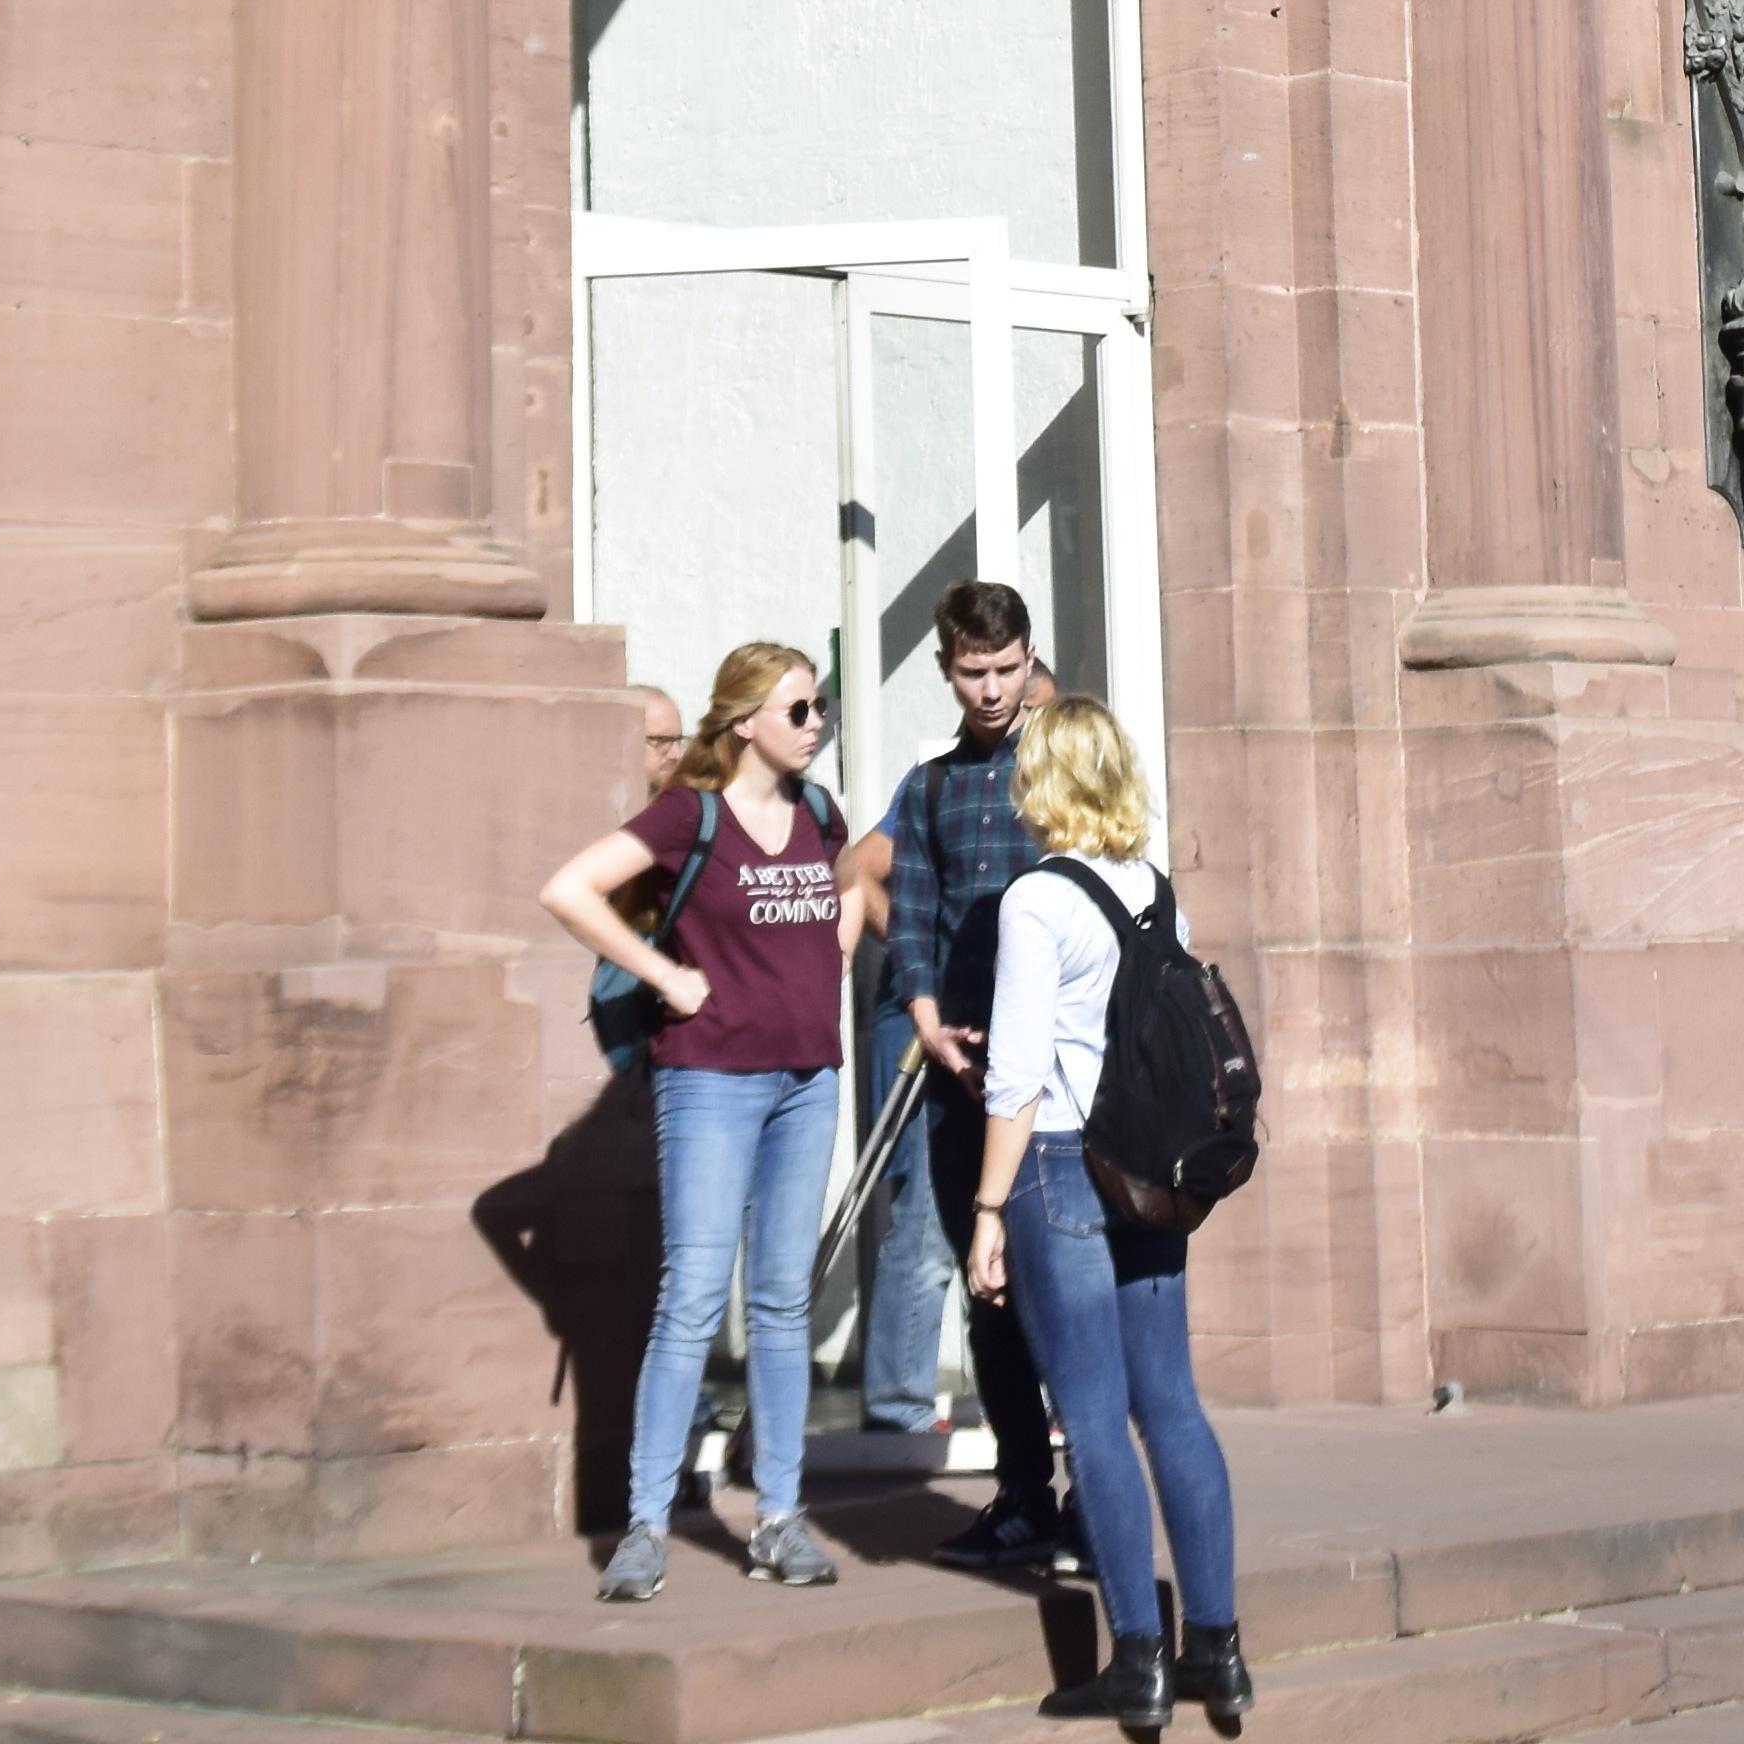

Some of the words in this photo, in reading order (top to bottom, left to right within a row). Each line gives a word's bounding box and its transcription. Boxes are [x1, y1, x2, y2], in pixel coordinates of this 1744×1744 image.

[736, 863, 755, 886] A
[755, 861, 833, 886] BETTER
[749, 896, 839, 925] COMING
